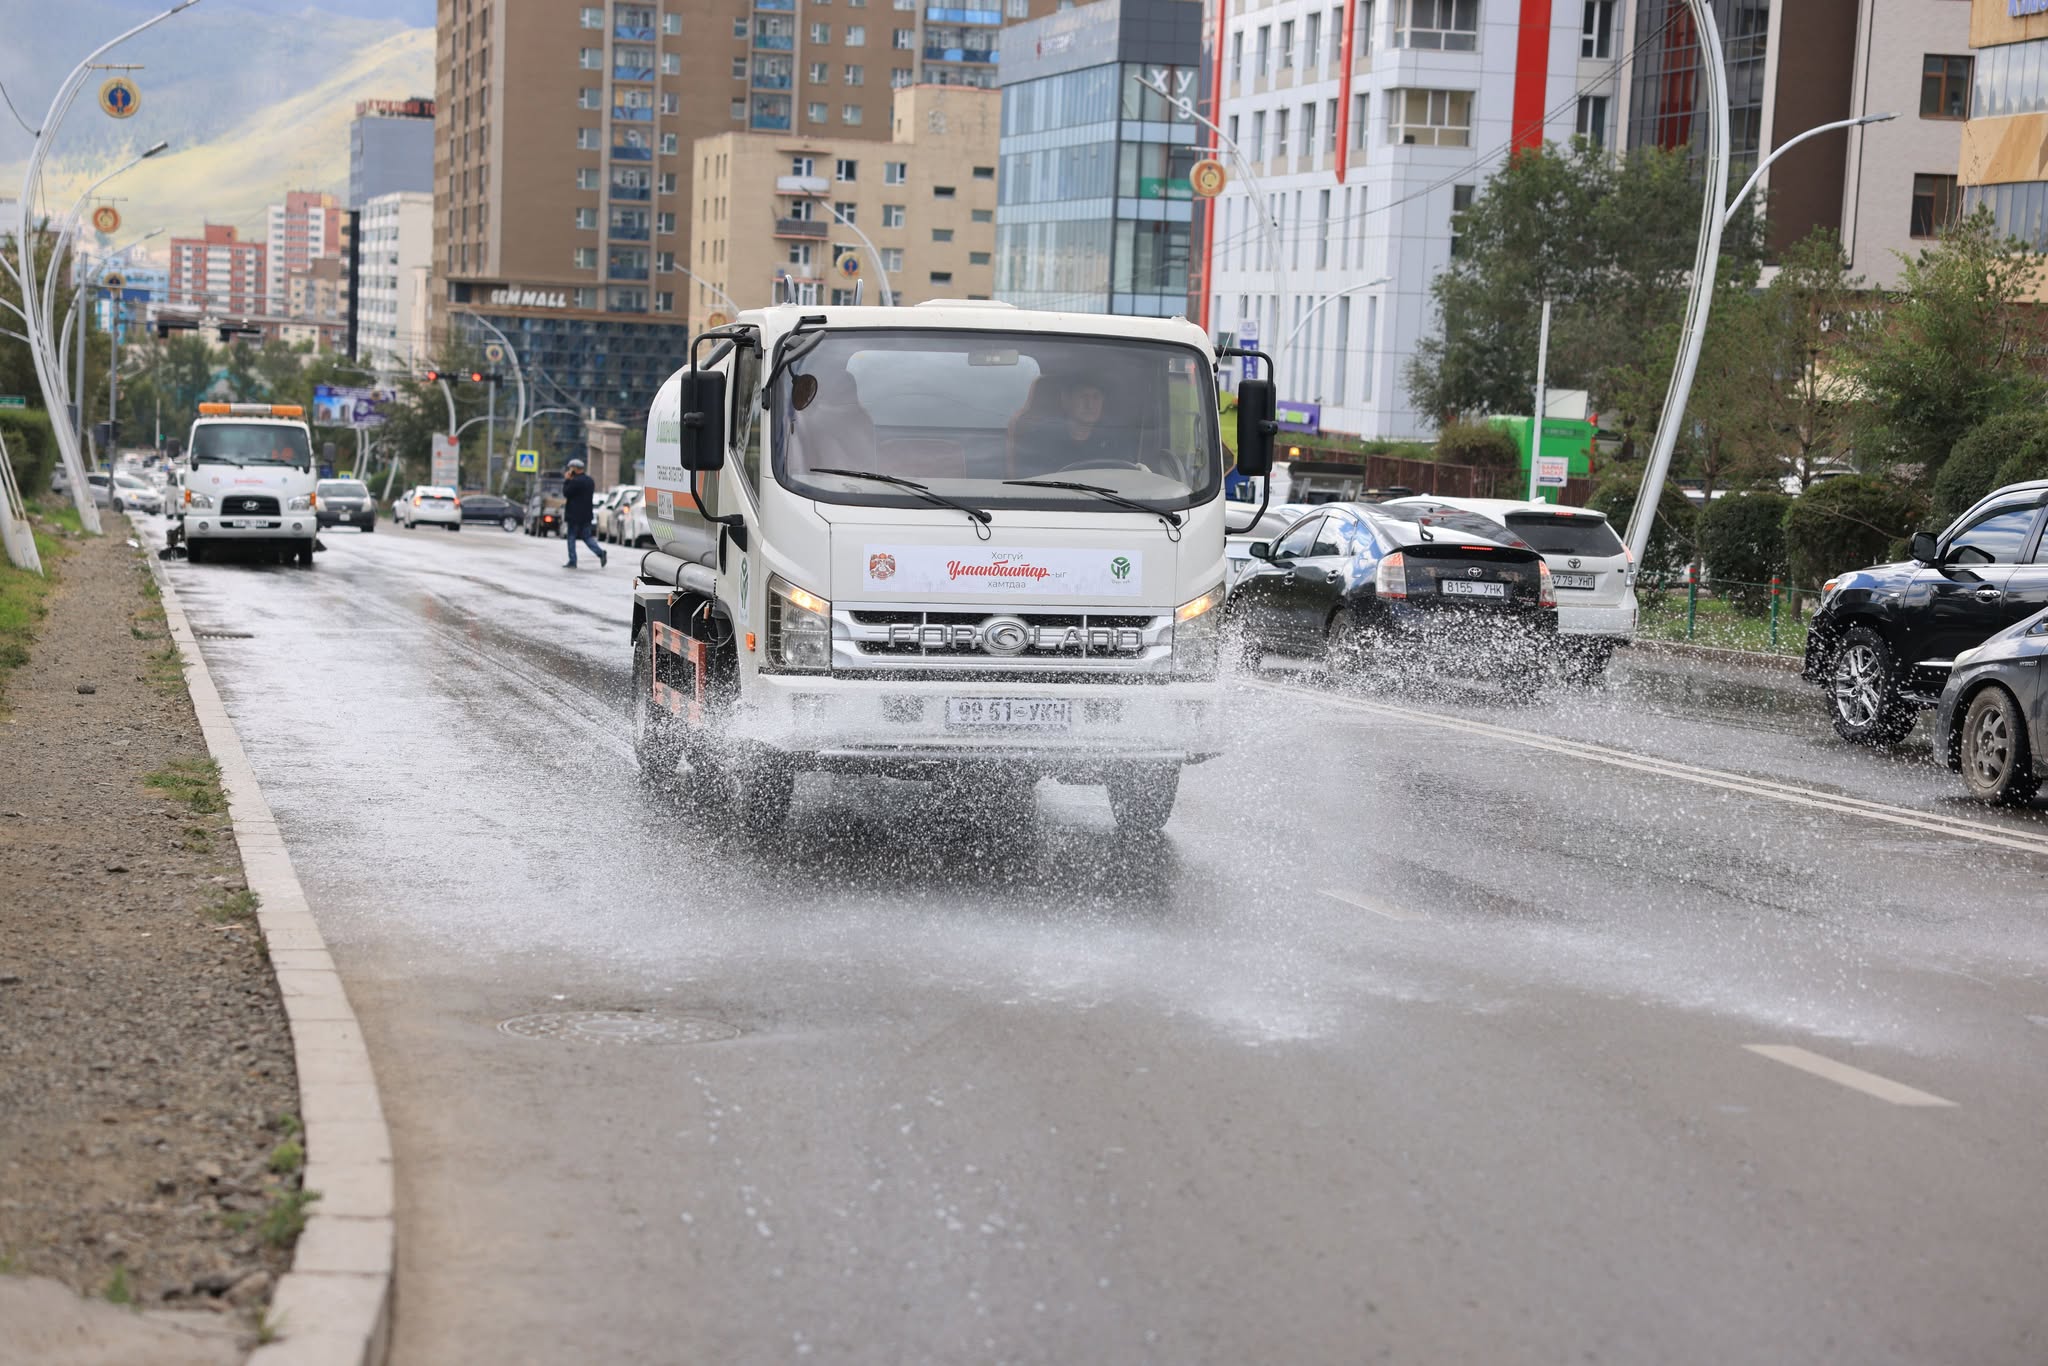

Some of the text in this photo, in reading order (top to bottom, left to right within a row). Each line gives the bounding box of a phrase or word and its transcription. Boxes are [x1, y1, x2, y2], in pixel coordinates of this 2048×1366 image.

[521, 291, 567, 307] MALL
[947, 560, 1050, 581] Улаанбаатар
[987, 581, 1026, 589] хамтдаа
[1447, 582, 1473, 594] 8155
